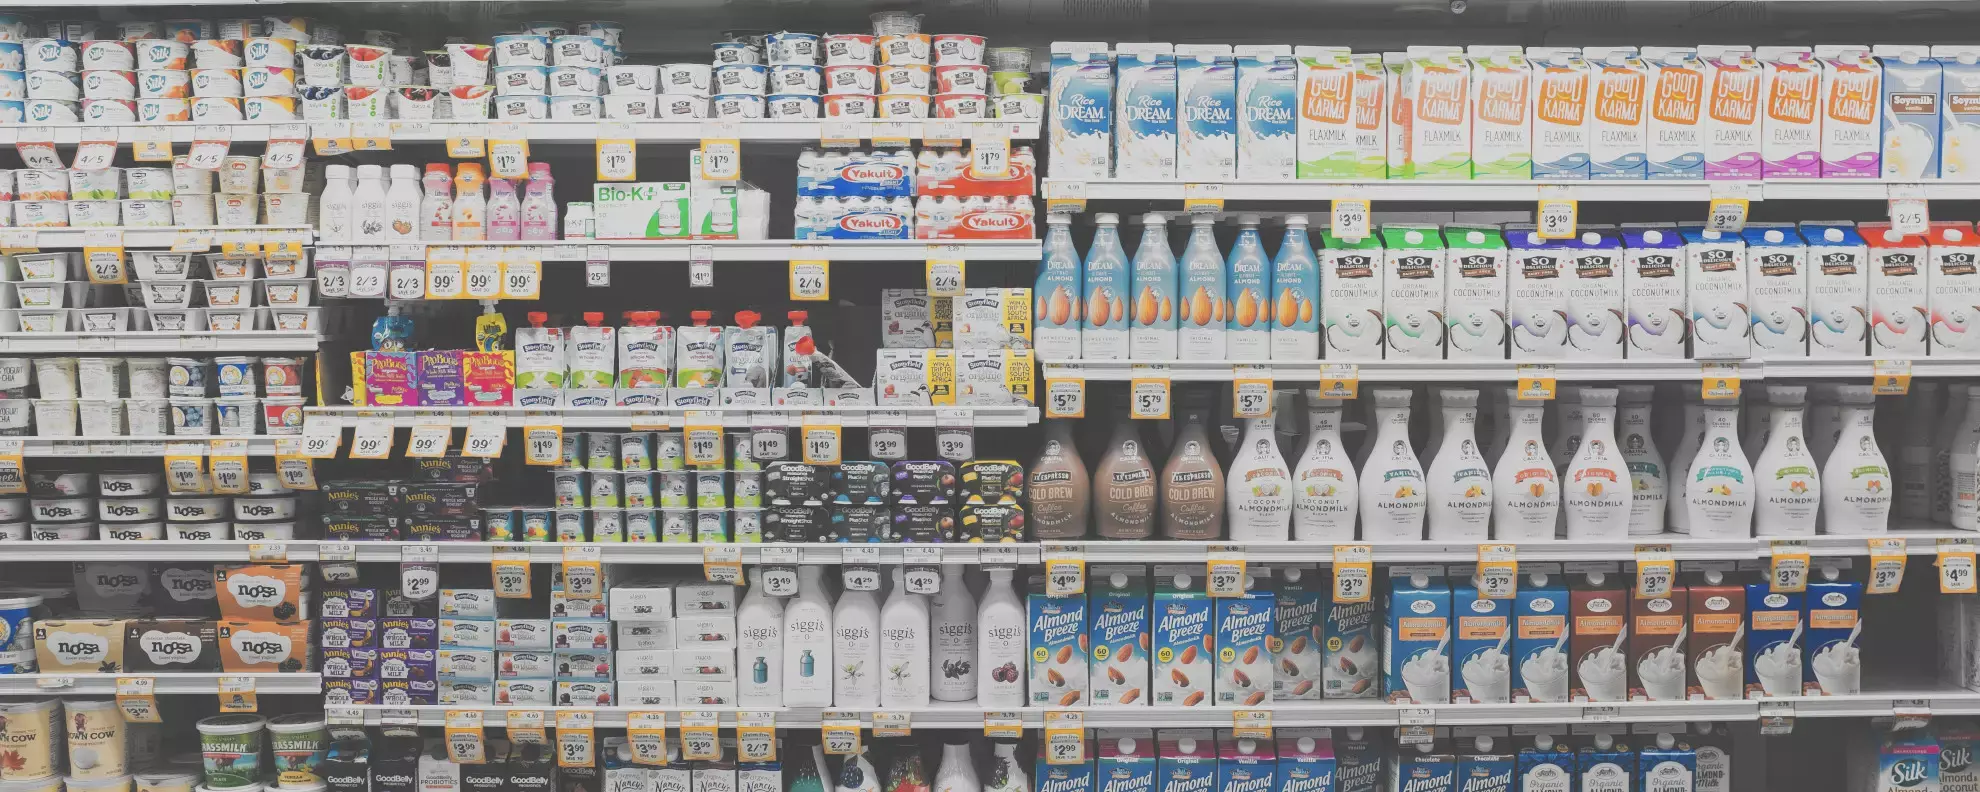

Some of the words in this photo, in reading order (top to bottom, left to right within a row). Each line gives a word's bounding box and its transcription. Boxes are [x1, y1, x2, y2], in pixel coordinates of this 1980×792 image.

[39, 45, 61, 61] Silk
[148, 46, 170, 62] Silk
[250, 44, 268, 60] Silk
[145, 74, 166, 92] Silk
[250, 72, 268, 88] Silk
[1663, 74, 1697, 98] GOOD
[1718, 74, 1754, 98] GOOD
[1836, 74, 1872, 98] GOOD
[1310, 76, 1347, 97] GOOD
[1426, 75, 1460, 98] GOOD
[1548, 76, 1582, 98] GOOD
[1604, 75, 1639, 98] GOOD
[1071, 94, 1094, 106] Rice
[1138, 94, 1162, 106] Rice
[1258, 95, 1282, 107] Rice
[1893, 96, 1932, 106] Soymilk
[32, 105, 52, 120] Silk
[1308, 100, 1346, 120] KARMA
[1422, 101, 1460, 121] KARMA
[1544, 101, 1582, 121] KARMA
[1601, 101, 1639, 121] KARMA
[1658, 100, 1696, 120] KARMA
[1714, 100, 1751, 120] KARMA
[1834, 100, 1872, 121] KARMA
[1309, 130, 1346, 141] FLAXMILK
[1424, 131, 1462, 142] FLAXMILK
[1544, 132, 1582, 142] FLAXMILK
[1602, 131, 1639, 142] FLAXMILK
[1659, 130, 1696, 142] FLAXMILK
[1716, 130, 1752, 141] FLAXMILK
[1834, 130, 1871, 141] FLAXMILK
[852, 168, 893, 178] Yakult
[851, 218, 892, 228] Yakult
[972, 217, 1014, 226] Yakult
[1708, 250, 1726, 258] SO
[1890, 254, 1908, 263] SO
[1344, 256, 1364, 265] SO
[1406, 256, 1424, 266] SO
[1584, 256, 1604, 266] SO
[1695, 282, 1743, 290] COCONUTMILK
[1876, 287, 1923, 296] COCONUTMILK
[1330, 289, 1379, 298] COCONUTMILK
[1391, 290, 1440, 298] COCONUTMILK
[1570, 290, 1619, 298] COCONUTMILK
[421, 458, 451, 469] Annie's
[781, 465, 816, 474] GoodBelly
[840, 464, 876, 473] GoodBelly
[972, 464, 1008, 473] GoodBelly
[103, 482, 132, 492] noosa
[1110, 488, 1132, 500] COLD
[1134, 486, 1154, 498] BREW
[406, 492, 436, 502] Annie's
[1168, 488, 1190, 500] COLD
[1192, 487, 1215, 499] BREW
[1180, 505, 1206, 513] Coffee
[1569, 500, 1624, 508] ALMONDMILK
[1692, 499, 1747, 507] ALMONDMILK
[40, 506, 72, 518] noosa
[107, 506, 139, 516] noosa
[243, 506, 272, 516] noosa
[238, 585, 277, 598] noosa
[1328, 600, 1374, 622] Almond
[1034, 606, 1083, 632] Almond
[1095, 605, 1144, 630] Almond
[1158, 608, 1208, 633] Almond
[1221, 608, 1270, 633] Almond
[1336, 612, 1370, 632] Breeze
[1045, 620, 1079, 642] Breeze
[1106, 620, 1140, 641] Breeze
[1170, 621, 1204, 642] Breeze
[1232, 621, 1266, 642] Breeze
[58, 642, 100, 654] noosa
[152, 642, 193, 654] noosa
[242, 642, 282, 654] noosa
[89, 730, 115, 740] COW
[1940, 748, 1972, 770] Silk
[1892, 761, 1928, 784] Silk
[328, 776, 365, 785] GoodBelly
[466, 776, 504, 786] GoodBelly
